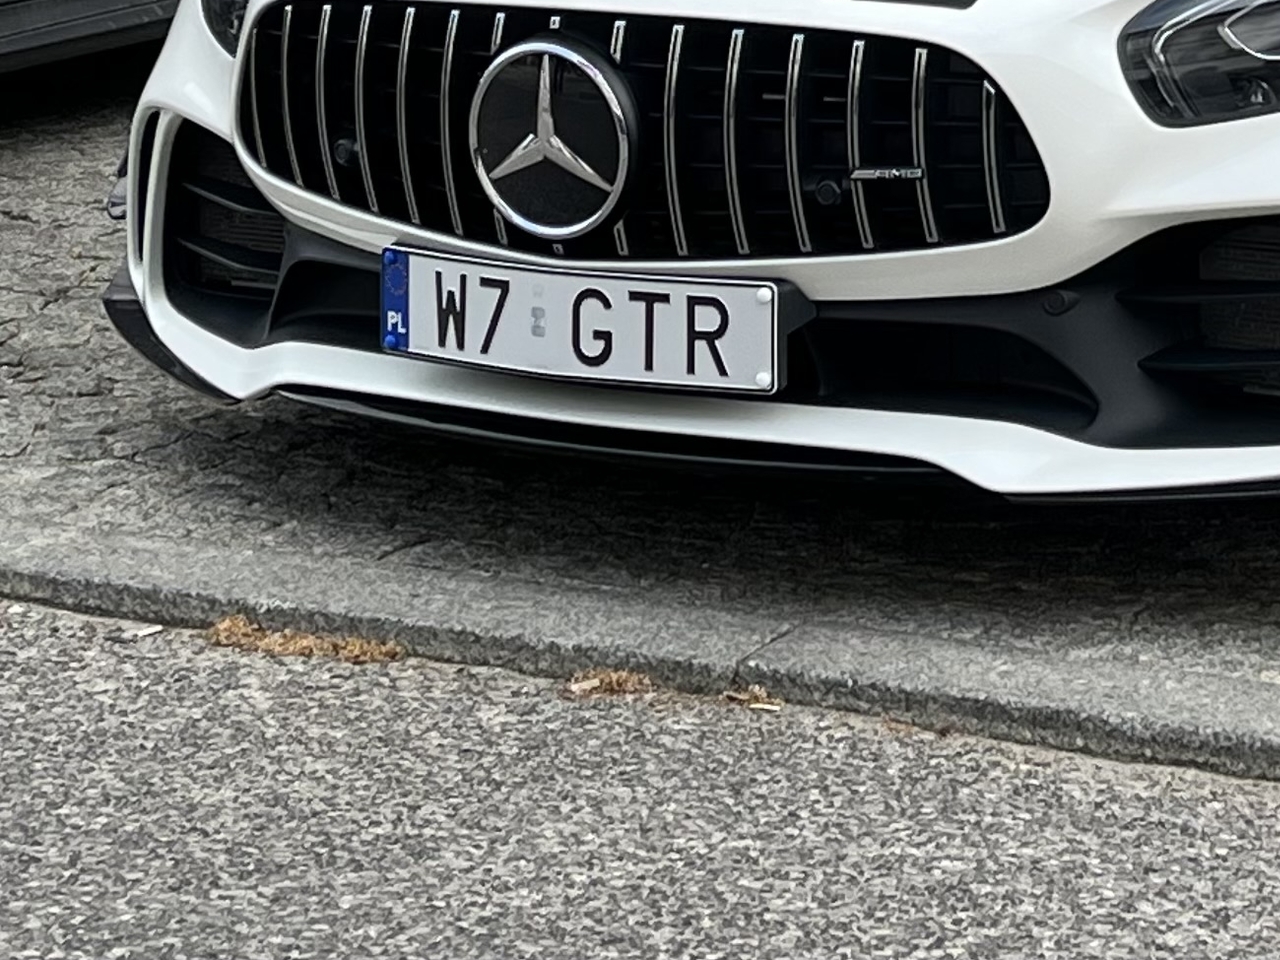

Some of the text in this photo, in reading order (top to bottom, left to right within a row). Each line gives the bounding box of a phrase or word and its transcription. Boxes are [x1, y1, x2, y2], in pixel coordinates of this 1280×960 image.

[387, 310, 407, 334] PL
[435, 270, 730, 377] W7 GTR
